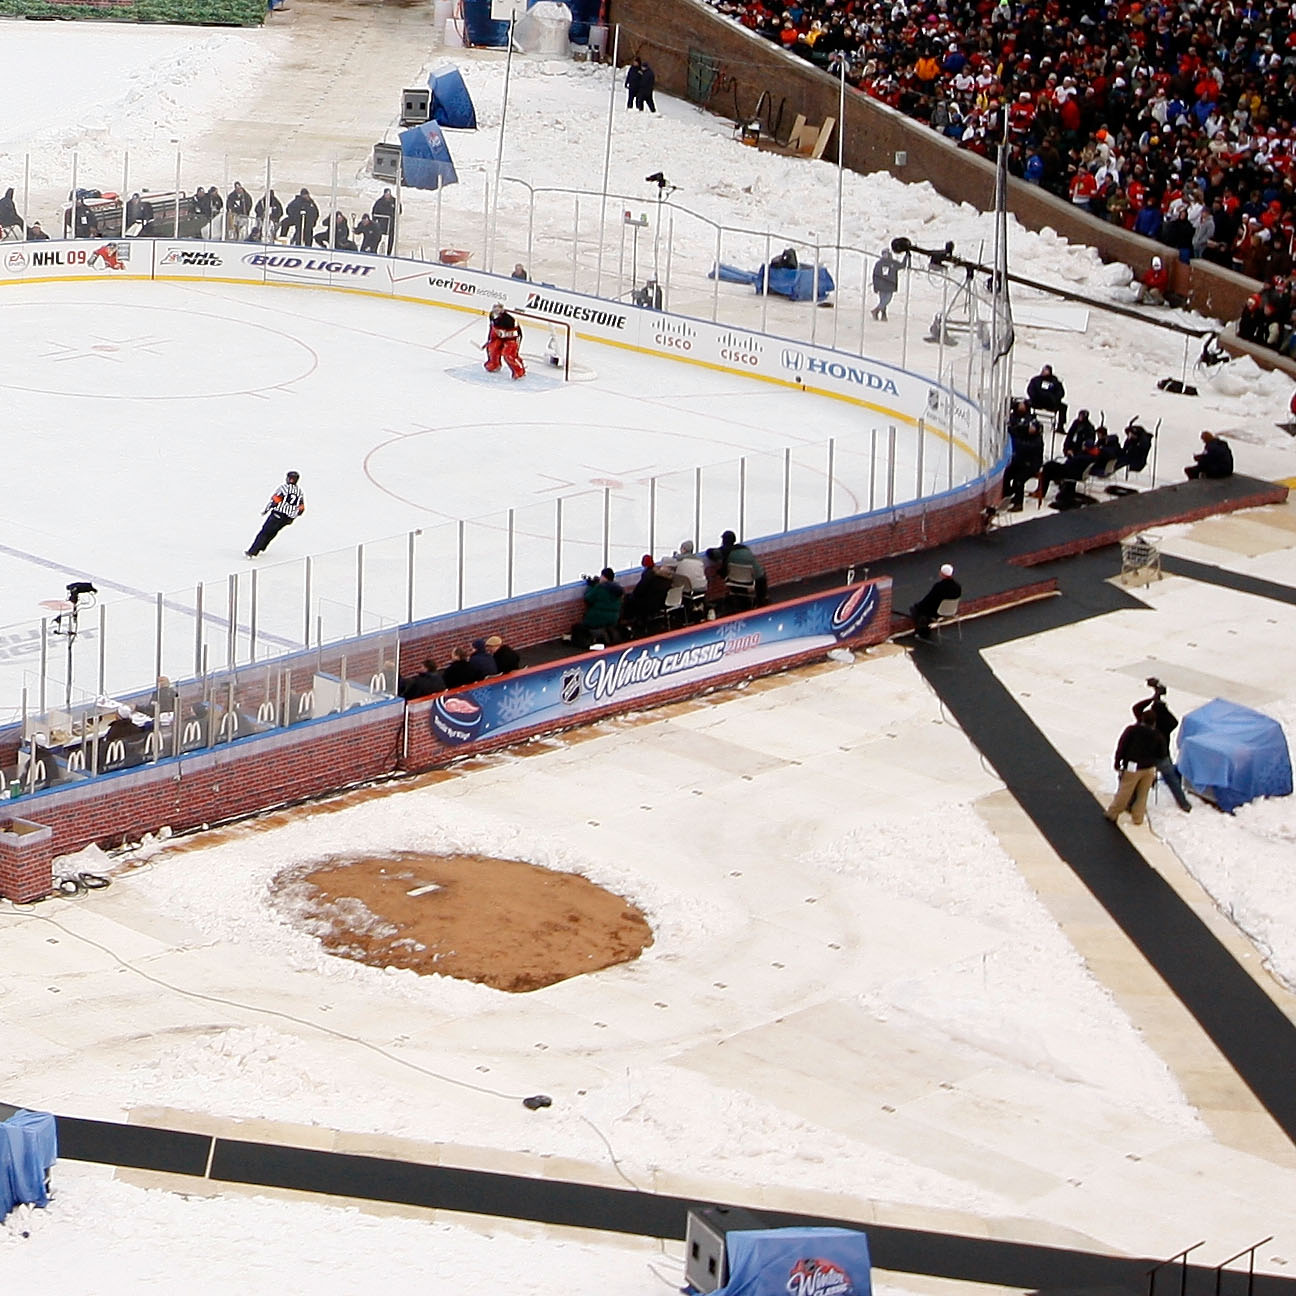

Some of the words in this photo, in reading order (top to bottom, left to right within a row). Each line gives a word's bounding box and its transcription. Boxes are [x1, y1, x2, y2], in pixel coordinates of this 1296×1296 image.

[32, 252, 64, 268] NHL
[66, 252, 88, 267] 09
[182, 250, 218, 260] NHL
[250, 253, 299, 272] BUD
[304, 260, 378, 278] LIGHT
[427, 275, 477, 296] verizon
[525, 292, 628, 331] BRIDGESTONE
[654, 334, 693, 352] CISCO
[720, 349, 760, 367] CISCO
[807, 358, 901, 398] HONDA
[585, 647, 662, 698] Winter
[660, 640, 726, 674] CLASSIC
[724, 631, 761, 658] 2009
[786, 1267, 845, 1296] Winter
